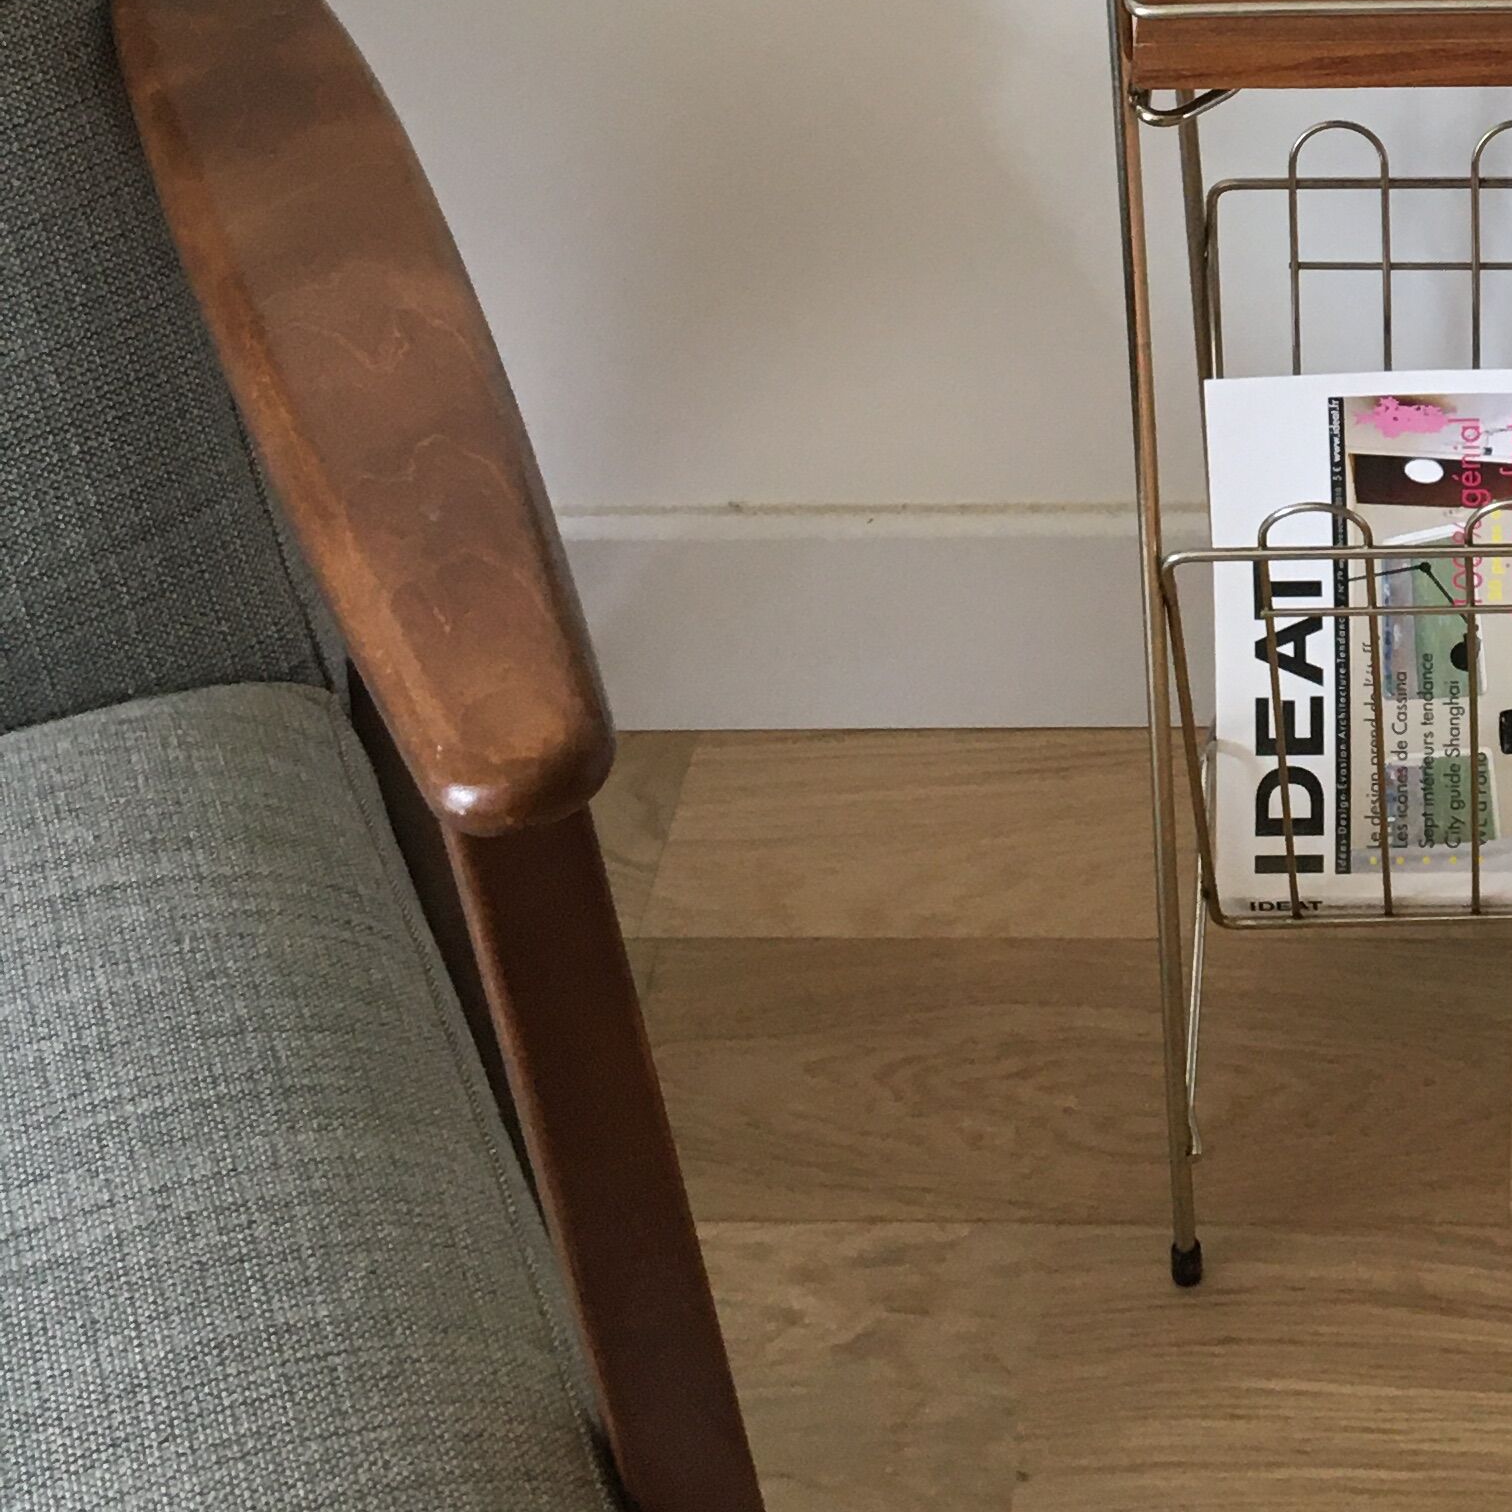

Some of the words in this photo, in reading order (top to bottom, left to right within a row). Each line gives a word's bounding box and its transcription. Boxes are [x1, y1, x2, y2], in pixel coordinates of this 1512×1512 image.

[1328, 399, 1341, 462] www.ideat.fr
[1447, 418, 1491, 507] génial
[1253, 560, 1325, 874] IDEAT
[1392, 671, 1408, 735] Cassina
[1417, 653, 1434, 726] tendance
[1443, 680, 1465, 758] Shanghai
[1391, 740, 1408, 762] de
[1418, 731, 1435, 806] intérieurs
[1391, 766, 1408, 817] icônes
[1443, 763, 1466, 810] guide
[1393, 824, 1408, 849] Les
[1418, 812, 1438, 849] Sept
[1445, 815, 1465, 849] City
